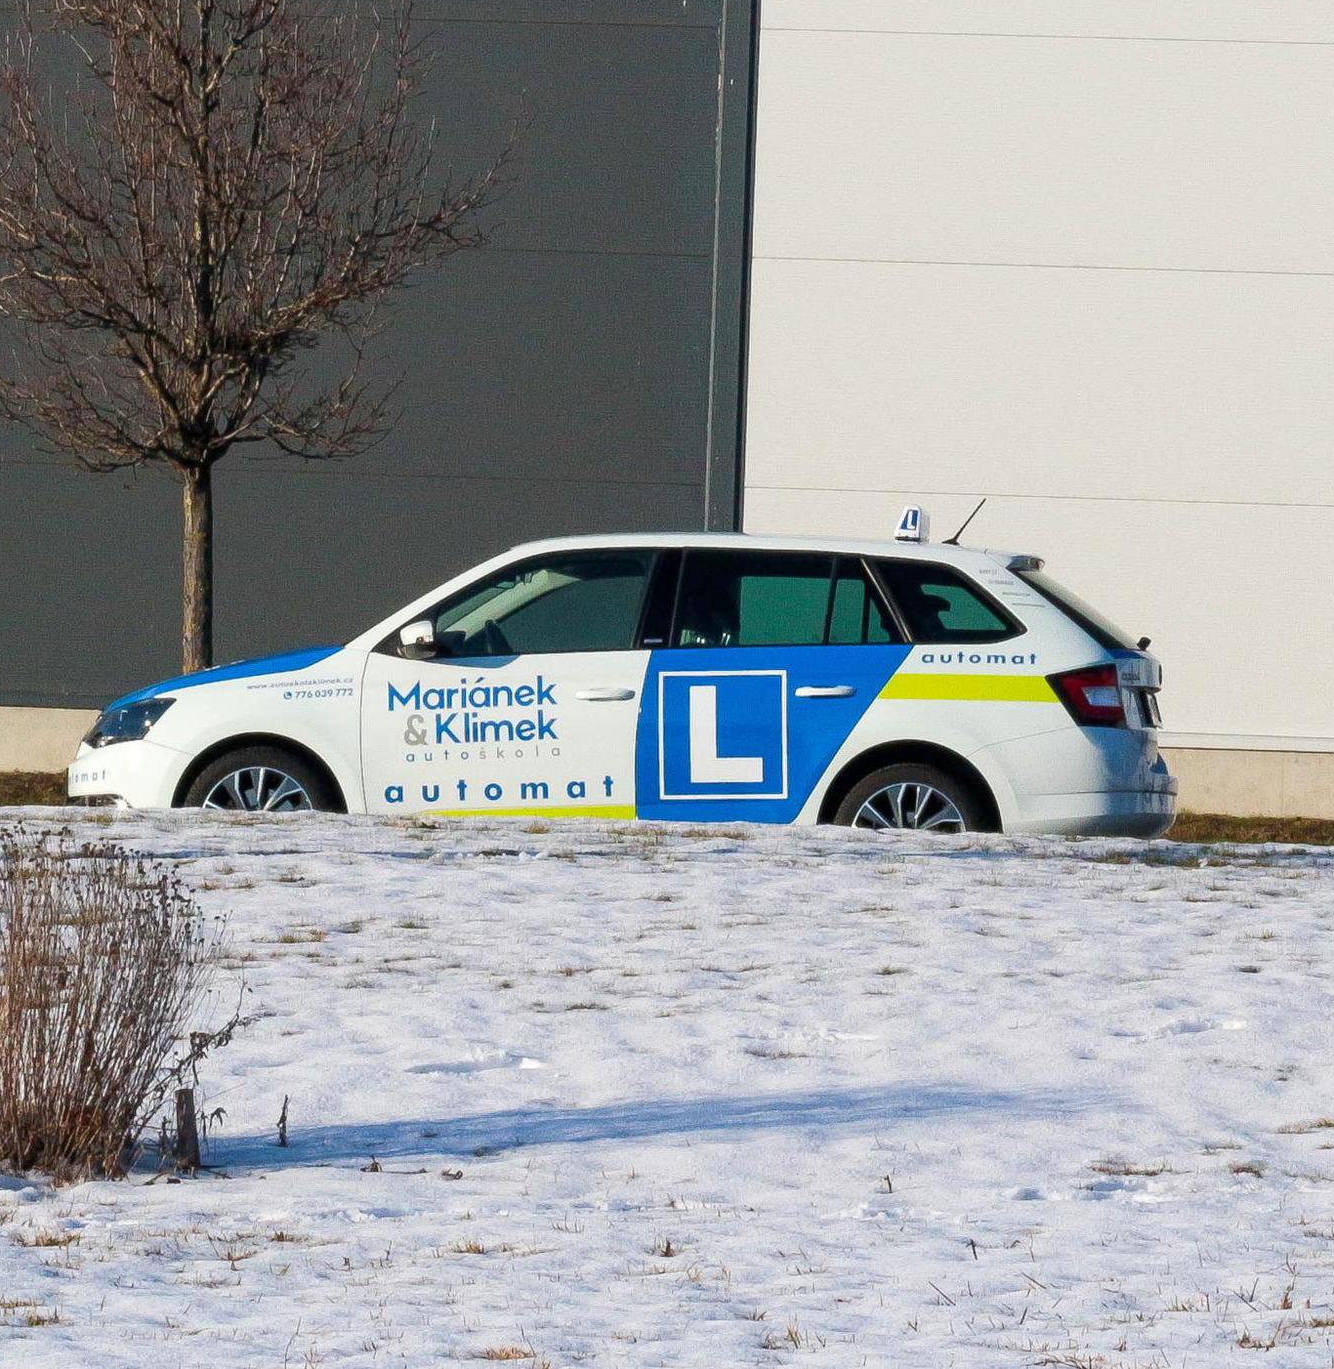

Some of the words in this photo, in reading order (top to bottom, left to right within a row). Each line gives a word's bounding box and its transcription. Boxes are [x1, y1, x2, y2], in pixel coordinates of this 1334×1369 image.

[906, 510, 916, 529] L
[921, 651, 1037, 665] automat
[295, 690, 314, 699] 776
[315, 689, 334, 698] 039
[335, 688, 354, 697] 772
[387, 675, 557, 712] Mariánek
[403, 714, 428, 746] &
[435, 711, 558, 744] Klimek
[690, 686, 764, 783] L
[405, 744, 561, 763] autoškola
[384, 775, 614, 804] automat
